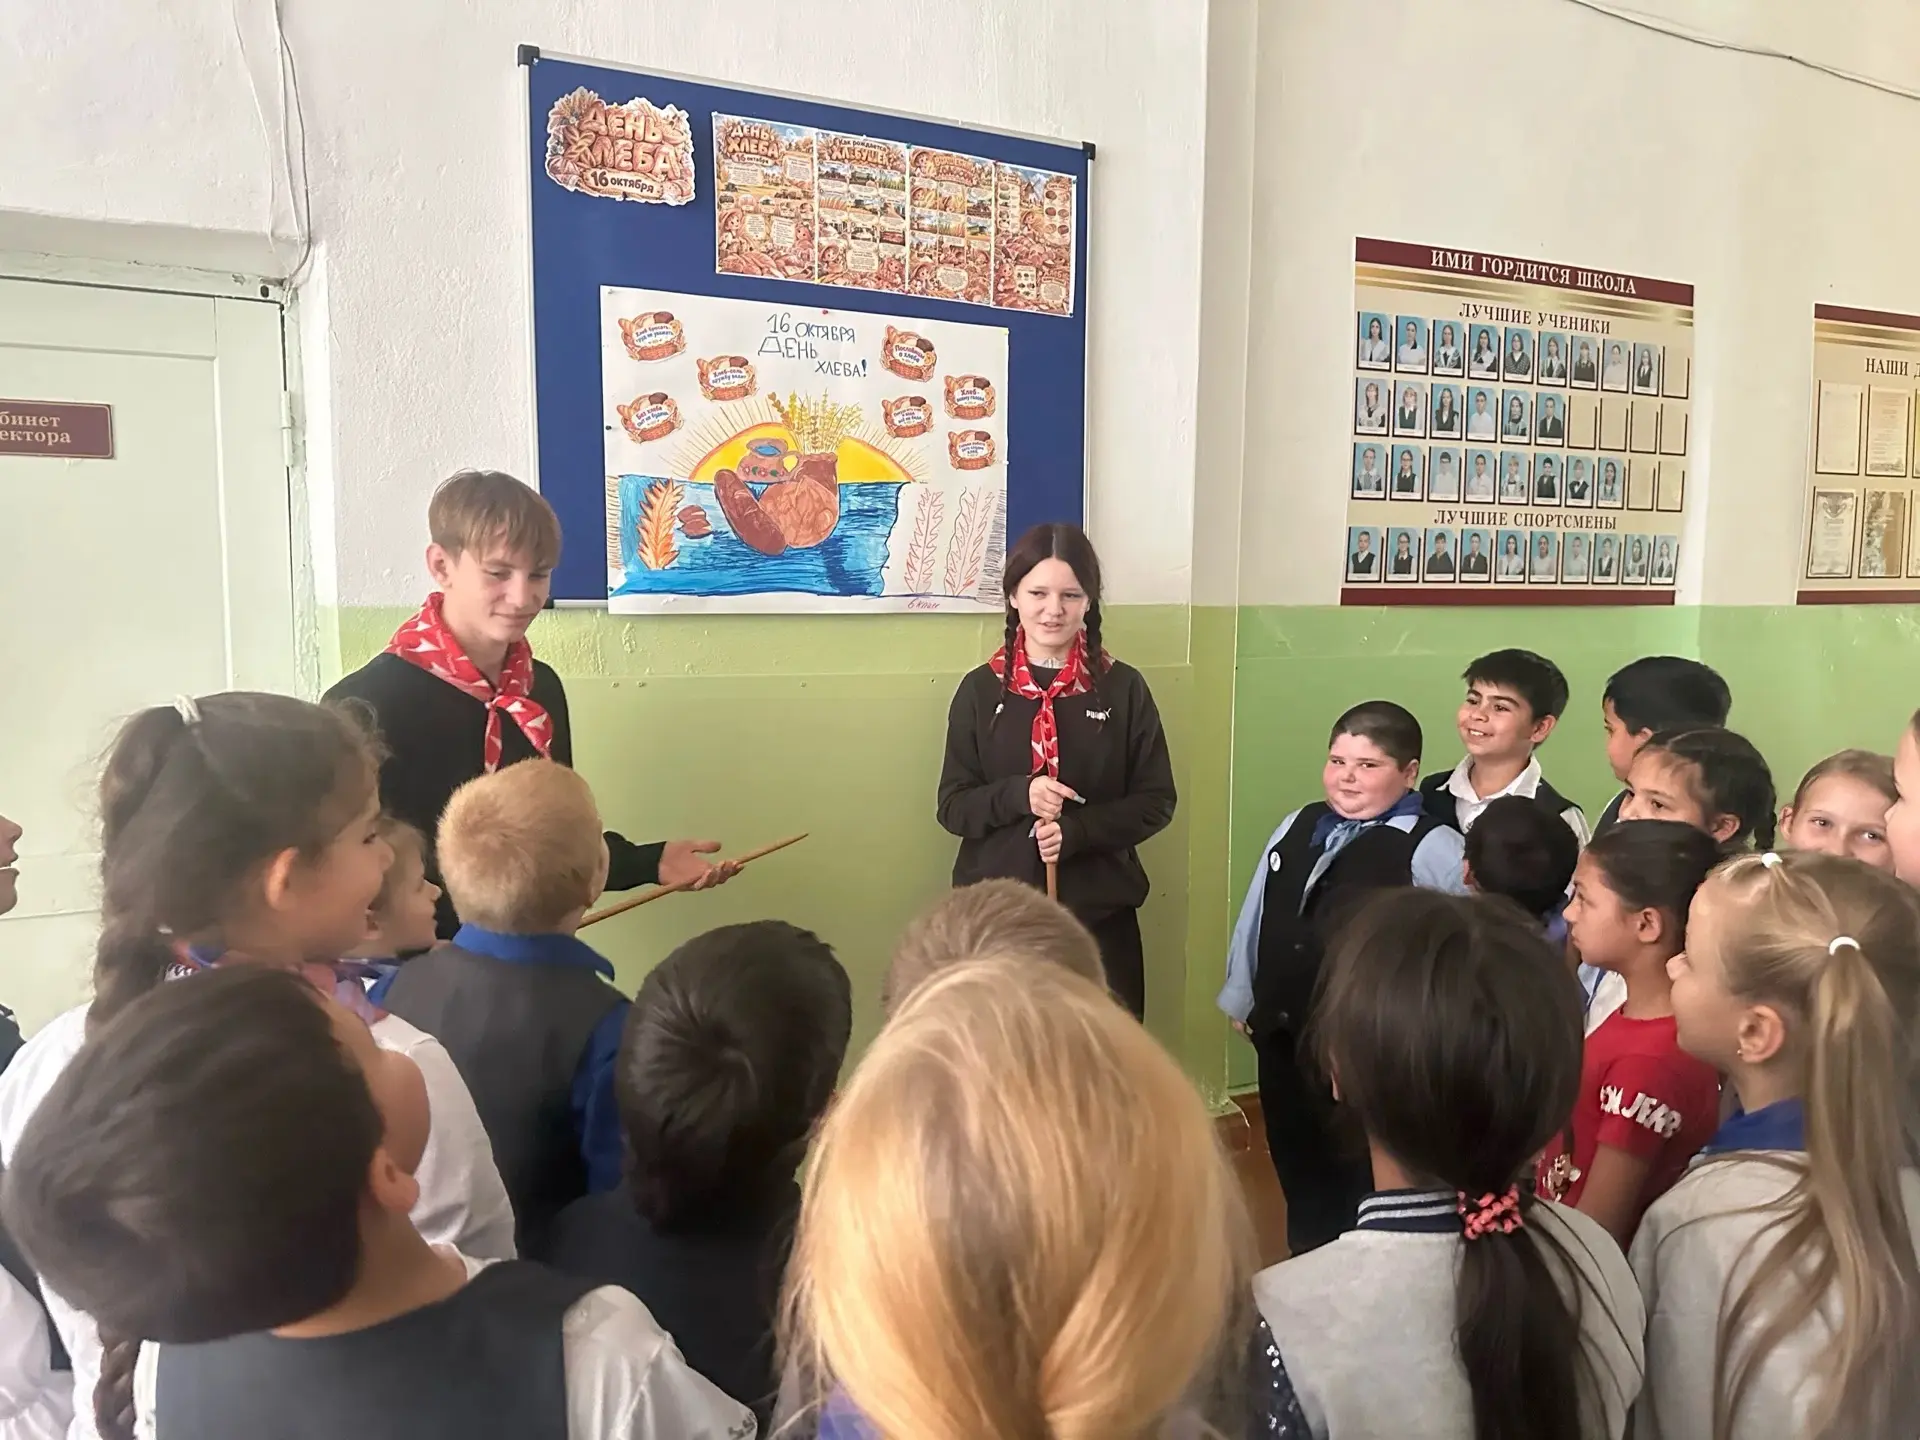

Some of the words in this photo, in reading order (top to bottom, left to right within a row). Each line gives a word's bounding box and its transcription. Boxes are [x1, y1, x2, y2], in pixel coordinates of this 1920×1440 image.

[579, 101, 663, 143] ДЕНЬ
[731, 124, 769, 141] ДЕНЬ
[563, 127, 681, 180] ХЛЕБА
[727, 137, 780, 159] ХЛЕБА
[591, 171, 609, 187] 16
[610, 179, 654, 194] октября
[1431, 250, 1474, 271] ИМИ
[1481, 256, 1571, 285] ГОРДИТСЯ
[1577, 271, 1637, 294] ШКОЛА
[767, 312, 791, 333] 16
[795, 322, 856, 344] ОКТЯБРЯ
[1459, 303, 1532, 325] ЛУЧШИЕ
[1538, 313, 1611, 334] УЧЕНИКИ
[758, 336, 818, 360] ДЕНЬ
[815, 359, 867, 377] ХЛЕБА!
[1866, 357, 1909, 377] НАШИ
[0, 411, 60, 427] бинет
[0, 430, 71, 446] ектора
[1434, 510, 1508, 526] ЛУЧШИЕ
[1514, 513, 1617, 530] СПОРТСМЕНЫ
